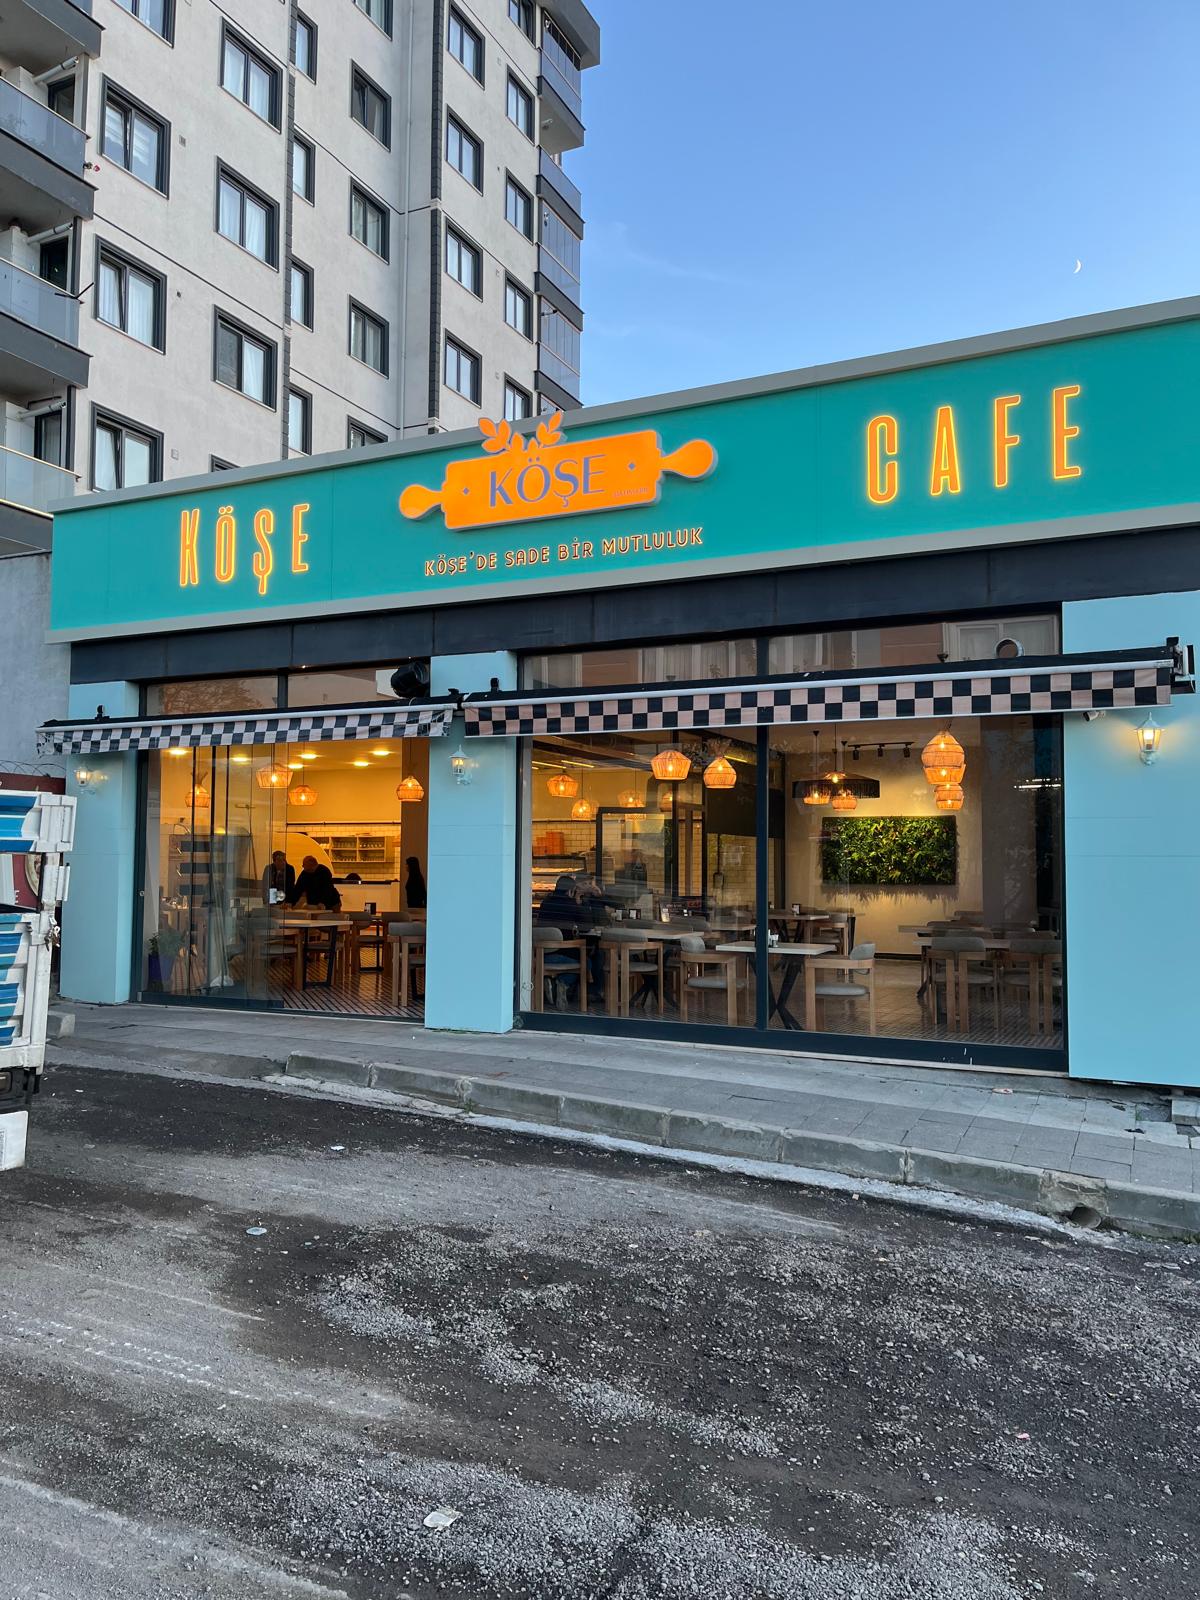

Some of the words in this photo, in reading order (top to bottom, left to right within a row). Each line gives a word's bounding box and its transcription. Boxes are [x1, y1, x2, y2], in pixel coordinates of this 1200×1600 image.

[488, 453, 607, 507] KÖŞE
[867, 384, 1081, 504] CAFE
[179, 502, 310, 595] KÖŞE
[424, 551, 497, 577] KÖŞE'DE
[504, 546, 550, 568] SADE
[557, 536, 594, 561] BİR
[601, 526, 703, 556] MUTLULUK
